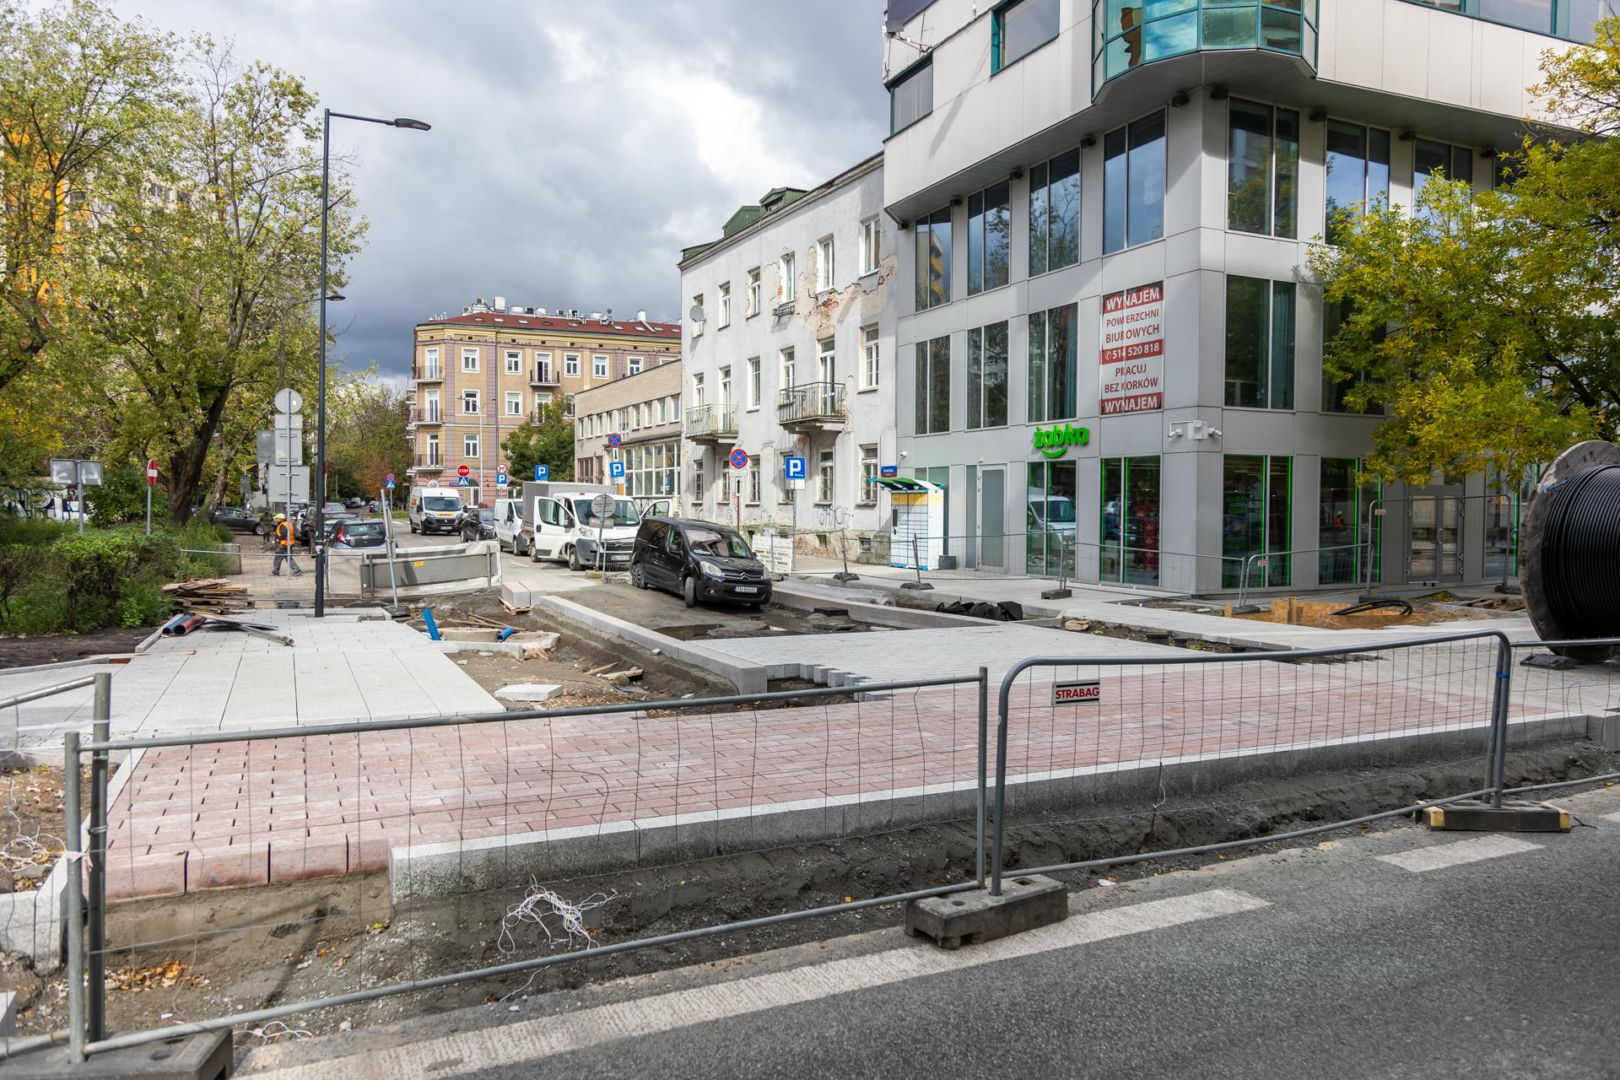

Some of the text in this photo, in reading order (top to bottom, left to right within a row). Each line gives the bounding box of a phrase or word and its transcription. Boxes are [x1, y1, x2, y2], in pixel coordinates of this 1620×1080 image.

[1106, 287, 1160, 311] WYNAJEM
[1106, 308, 1159, 328] POWERZCHNI
[1128, 346, 1143, 357] 520
[1144, 342, 1160, 354] 818
[1104, 383, 1120, 394] BEZ
[1104, 395, 1158, 413] WYNAJEM
[1033, 422, 1089, 448] żabka
[790, 459, 801, 476] P
[1055, 687, 1100, 699] STRABAG
